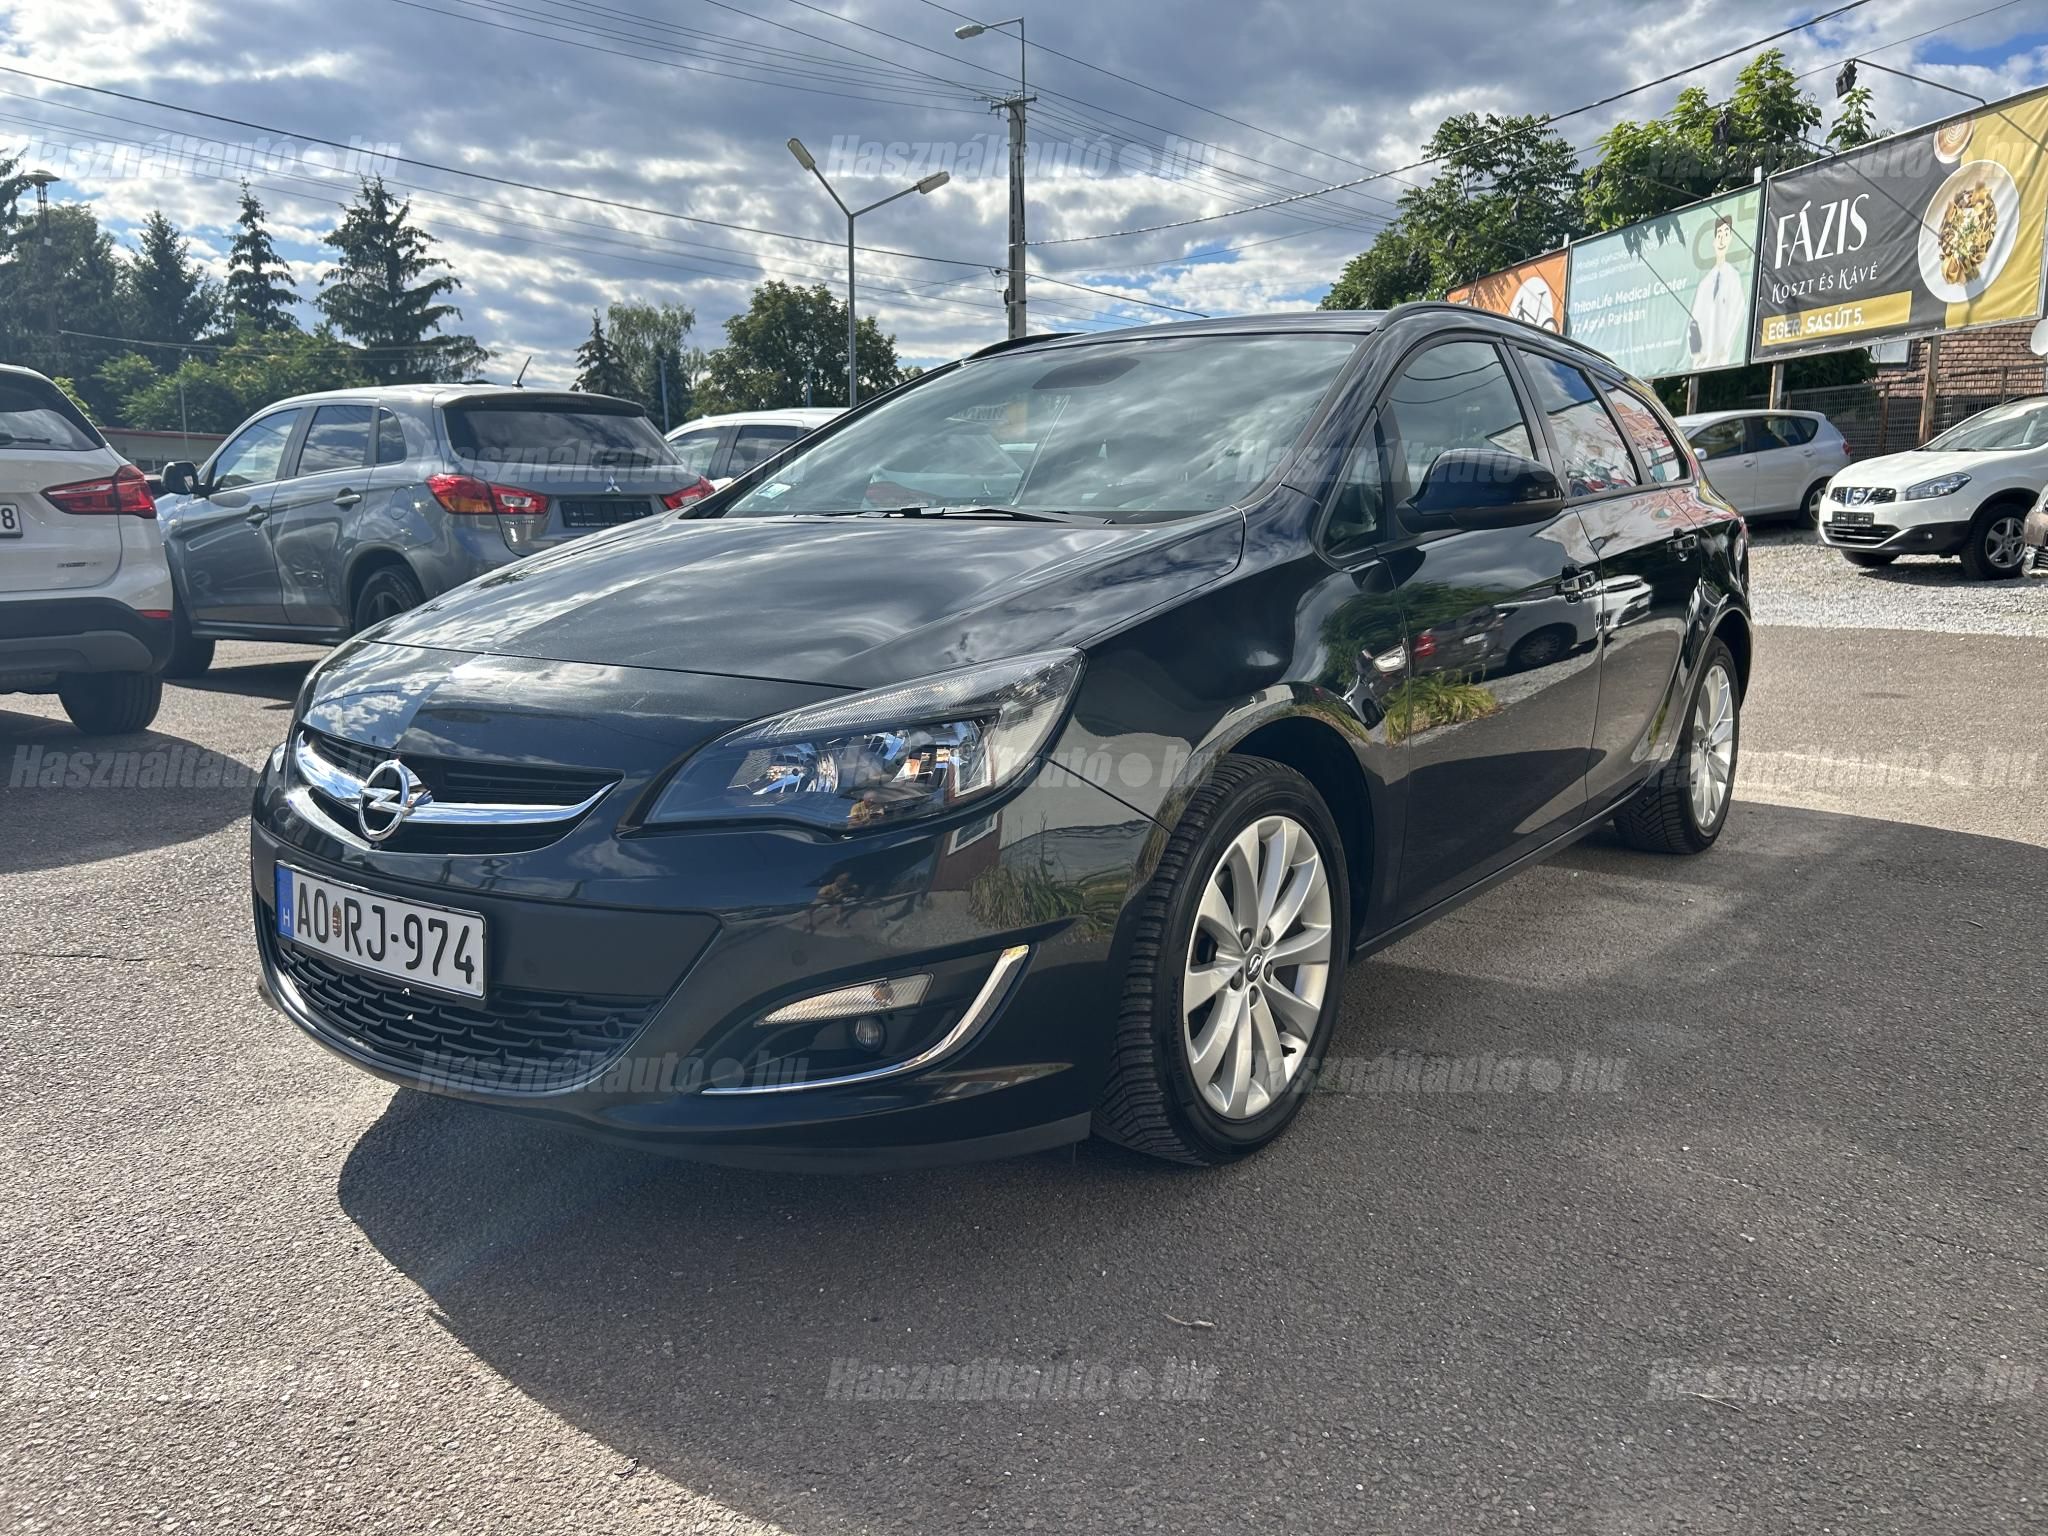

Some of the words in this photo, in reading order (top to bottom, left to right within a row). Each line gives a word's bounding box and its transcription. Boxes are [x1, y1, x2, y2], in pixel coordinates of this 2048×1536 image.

[1775, 194, 1869, 269] FÁZIS
[1615, 283, 1650, 305] Medical
[1653, 278, 1687, 295] Center
[1, 507, 15, 530] 8
[282, 907, 291, 928] H
